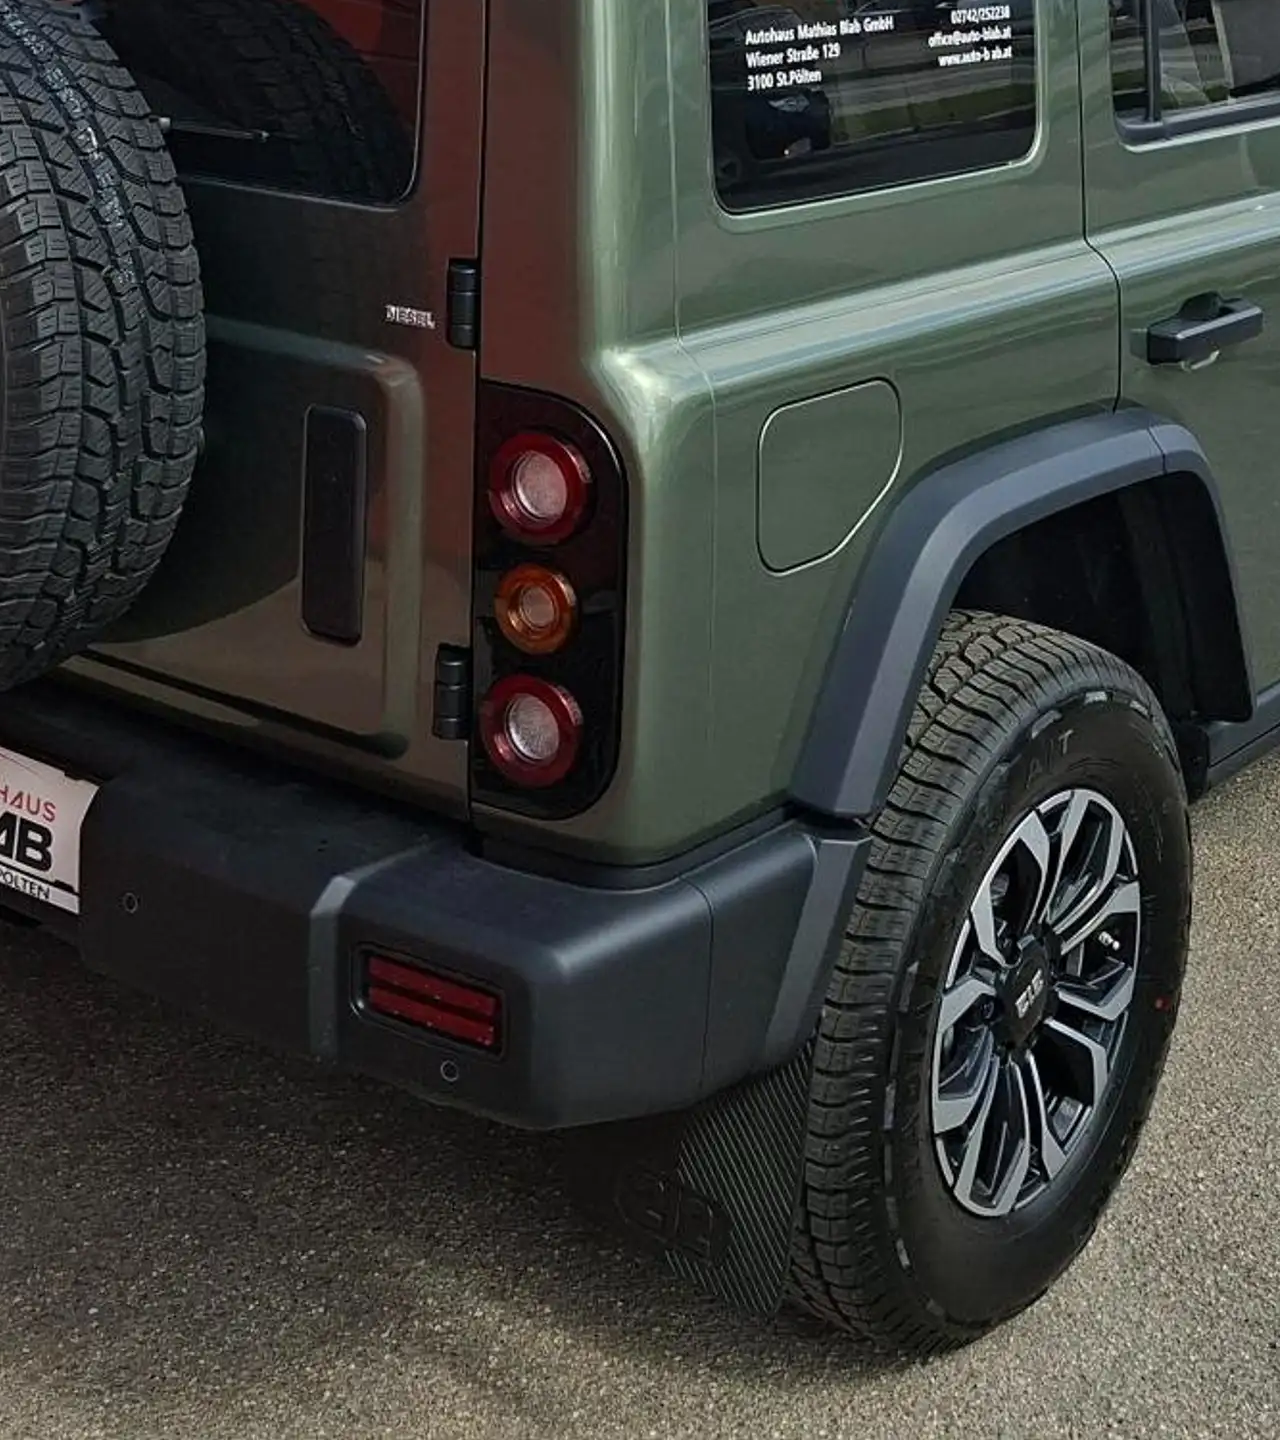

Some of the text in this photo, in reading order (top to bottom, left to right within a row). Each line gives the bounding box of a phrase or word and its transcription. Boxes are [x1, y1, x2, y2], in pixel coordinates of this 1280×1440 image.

[745, 28, 795, 46] Autohaus
[797, 21, 837, 41] Mathias
[863, 15, 895, 33] GmbH
[745, 42, 841, 68] Wiener Straße 129
[747, 72, 774, 92] 3100
